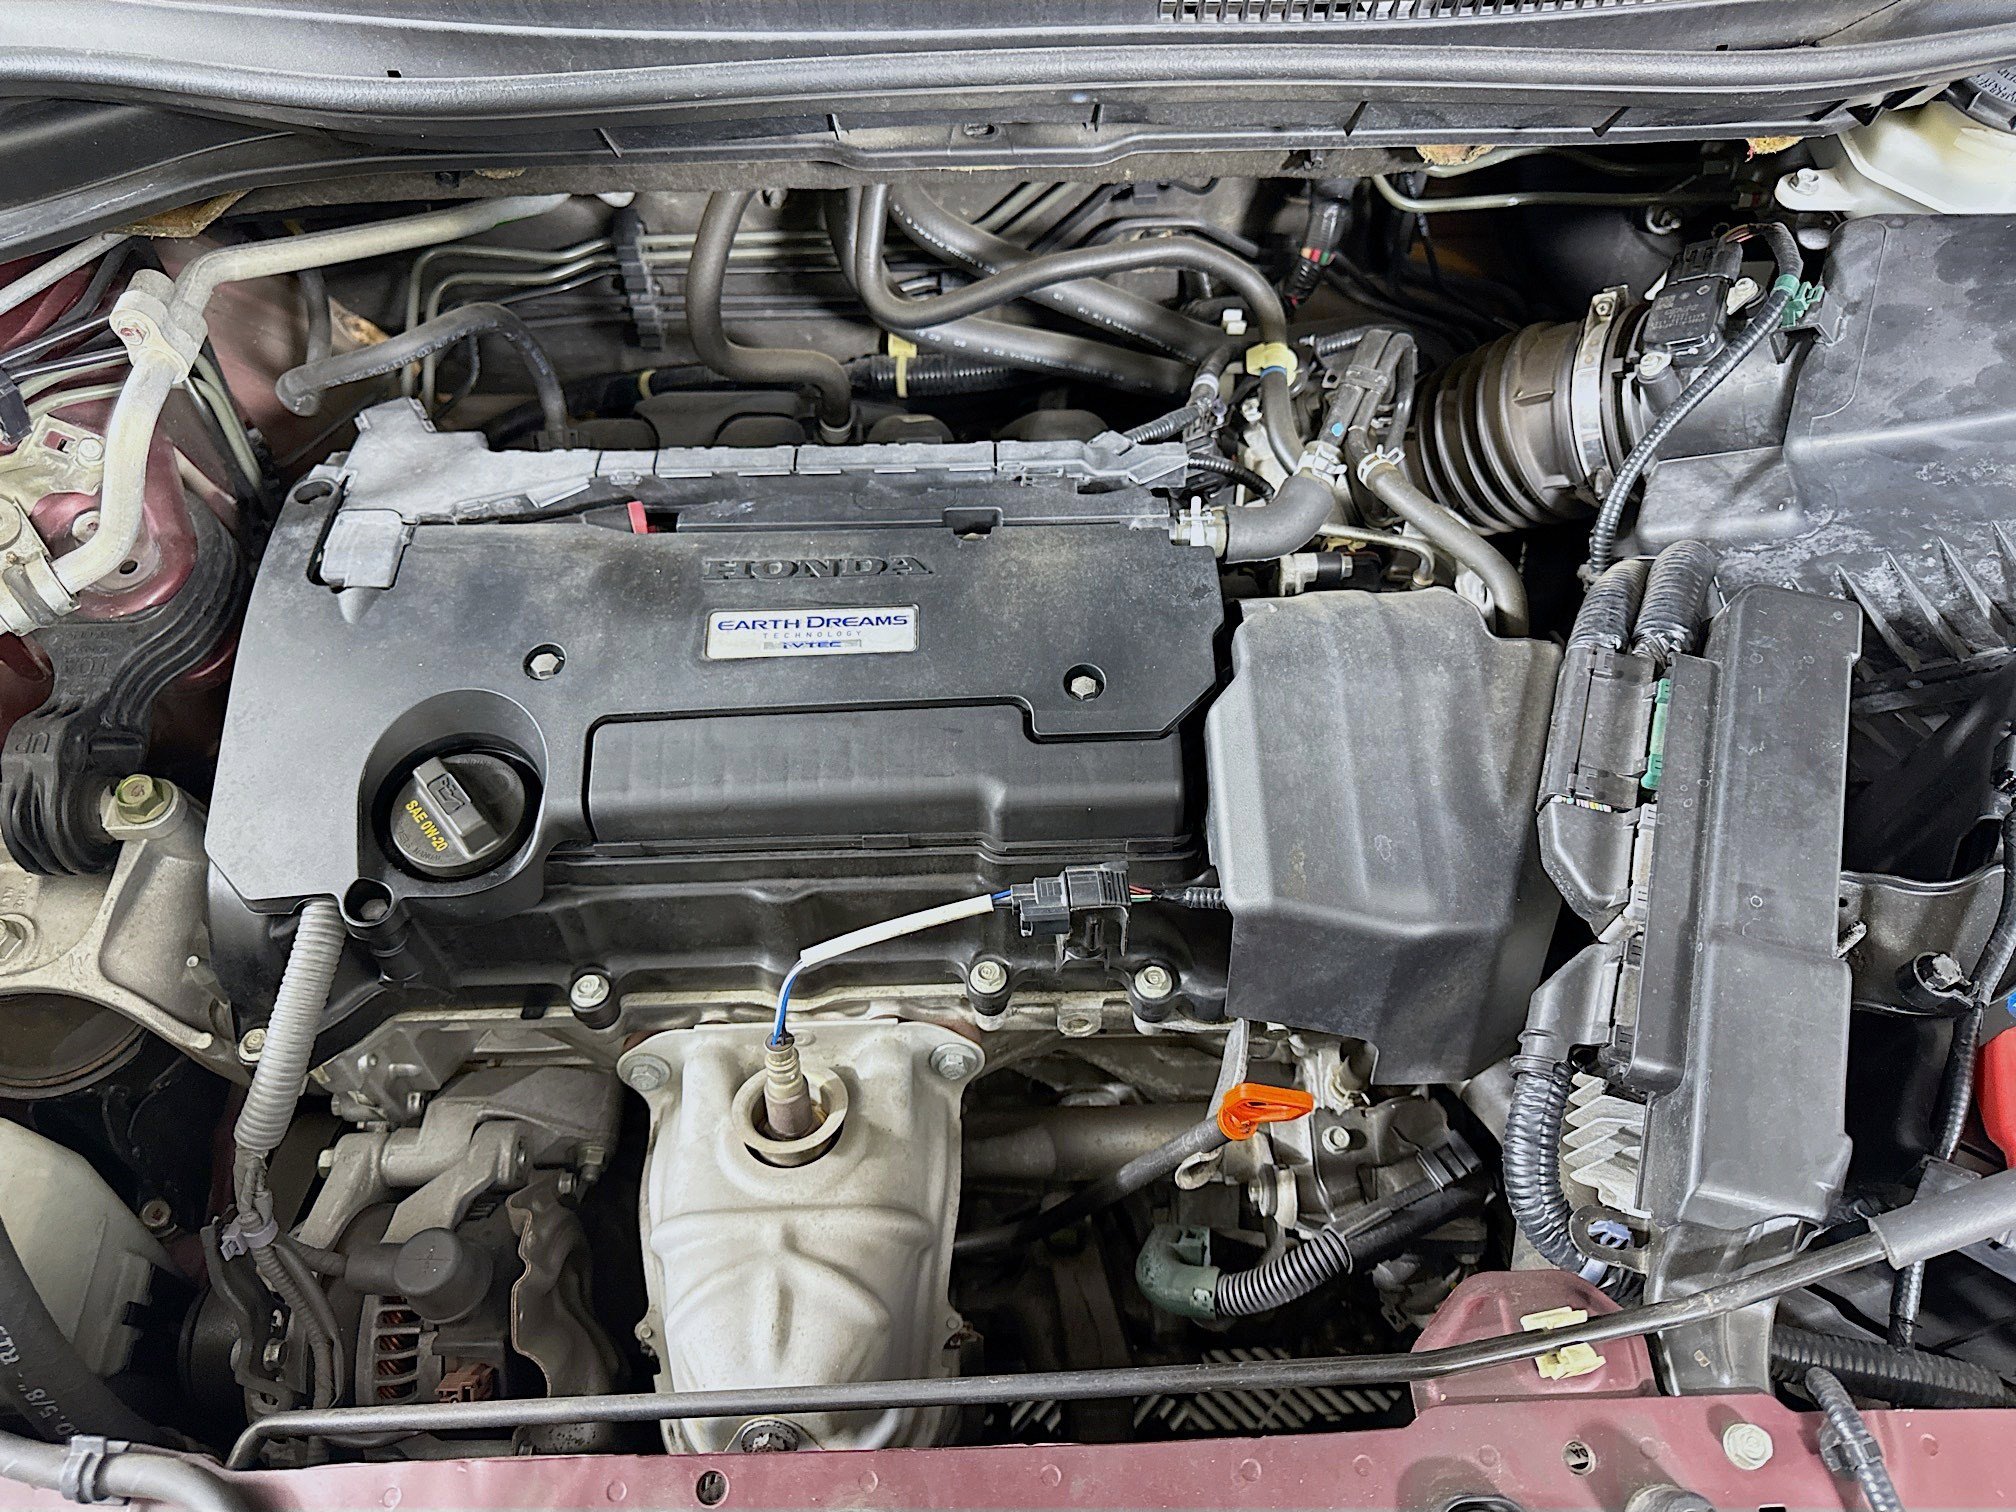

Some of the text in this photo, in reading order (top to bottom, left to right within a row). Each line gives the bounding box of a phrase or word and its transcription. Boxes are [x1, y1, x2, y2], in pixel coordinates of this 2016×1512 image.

[701, 556, 934, 580] HONDA
[717, 615, 908, 631] EARTH DREAMS
[763, 630, 863, 639] TECHNOLOGY
[405, 799, 429, 824] SAE
[420, 820, 449, 852] 0W-20
